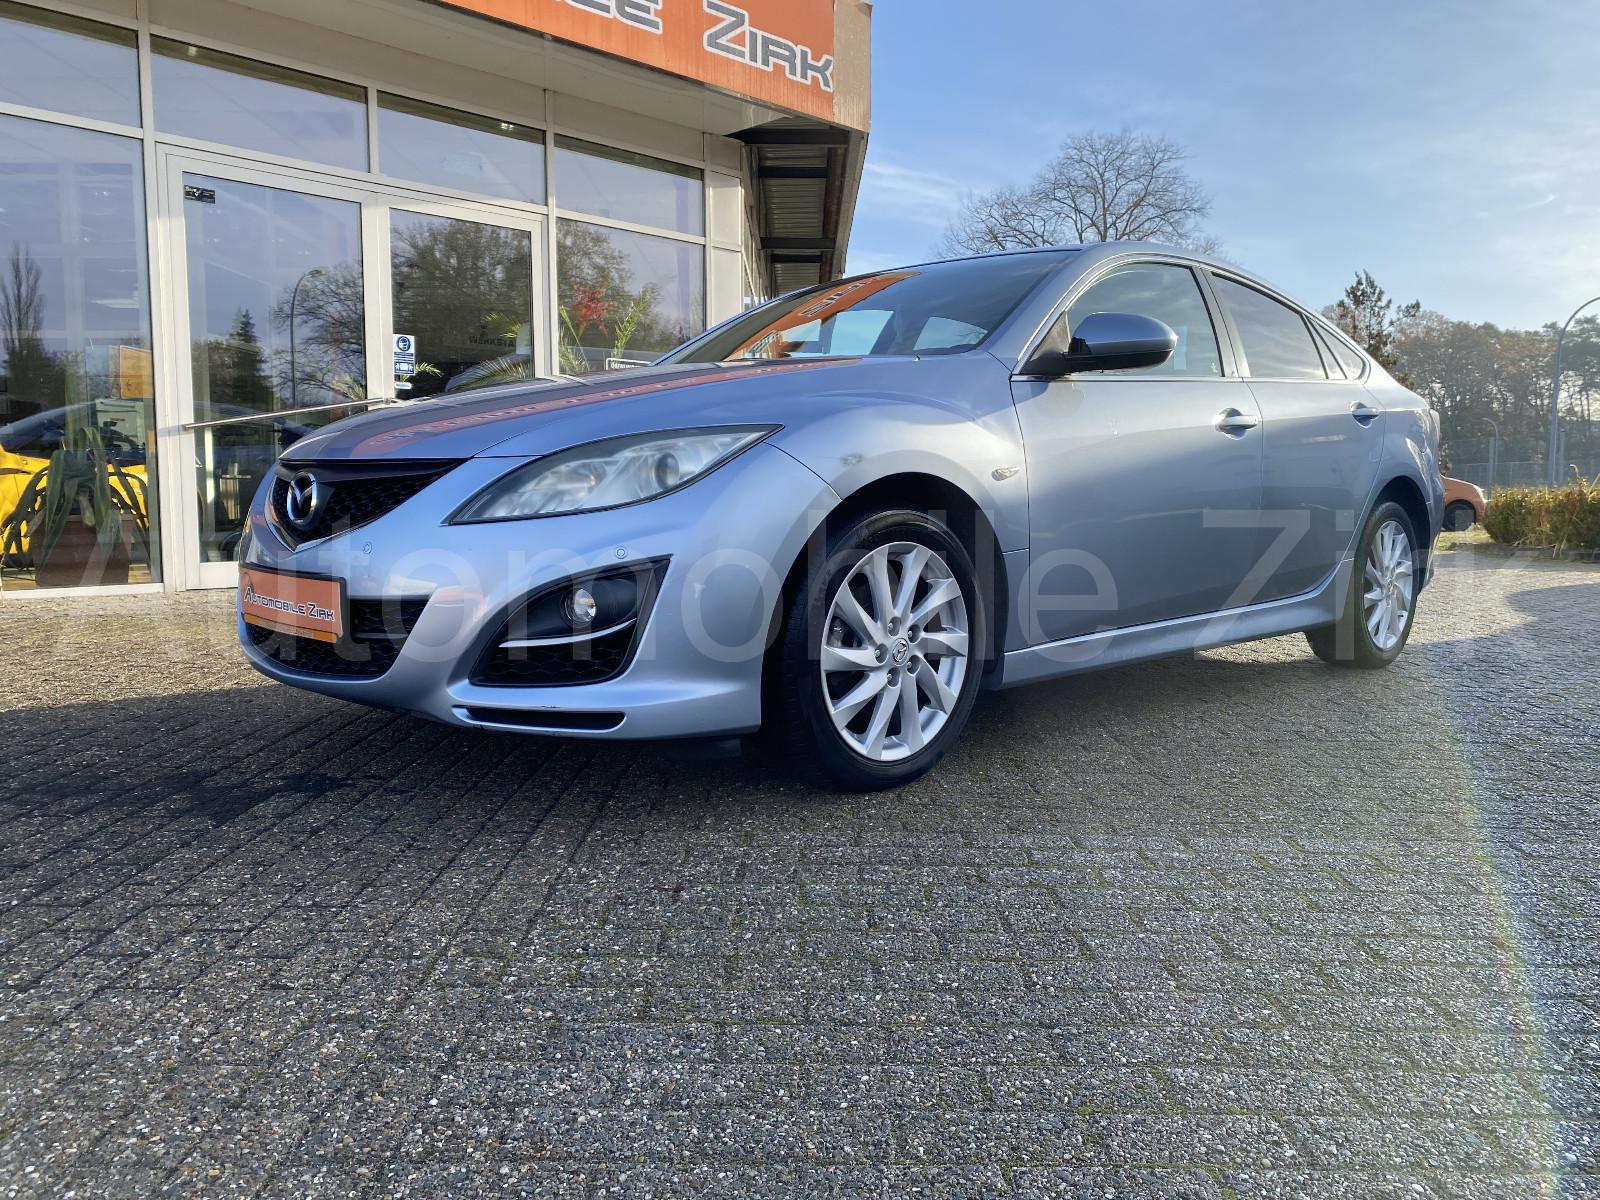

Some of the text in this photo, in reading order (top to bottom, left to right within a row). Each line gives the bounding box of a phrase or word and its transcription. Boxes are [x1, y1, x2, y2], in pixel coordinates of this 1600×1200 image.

[703, 0, 833, 91] ZIRK
[469, 335, 516, 348] WERKSTA
[244, 585, 335, 621] AUTOMOBILE ZIRK
